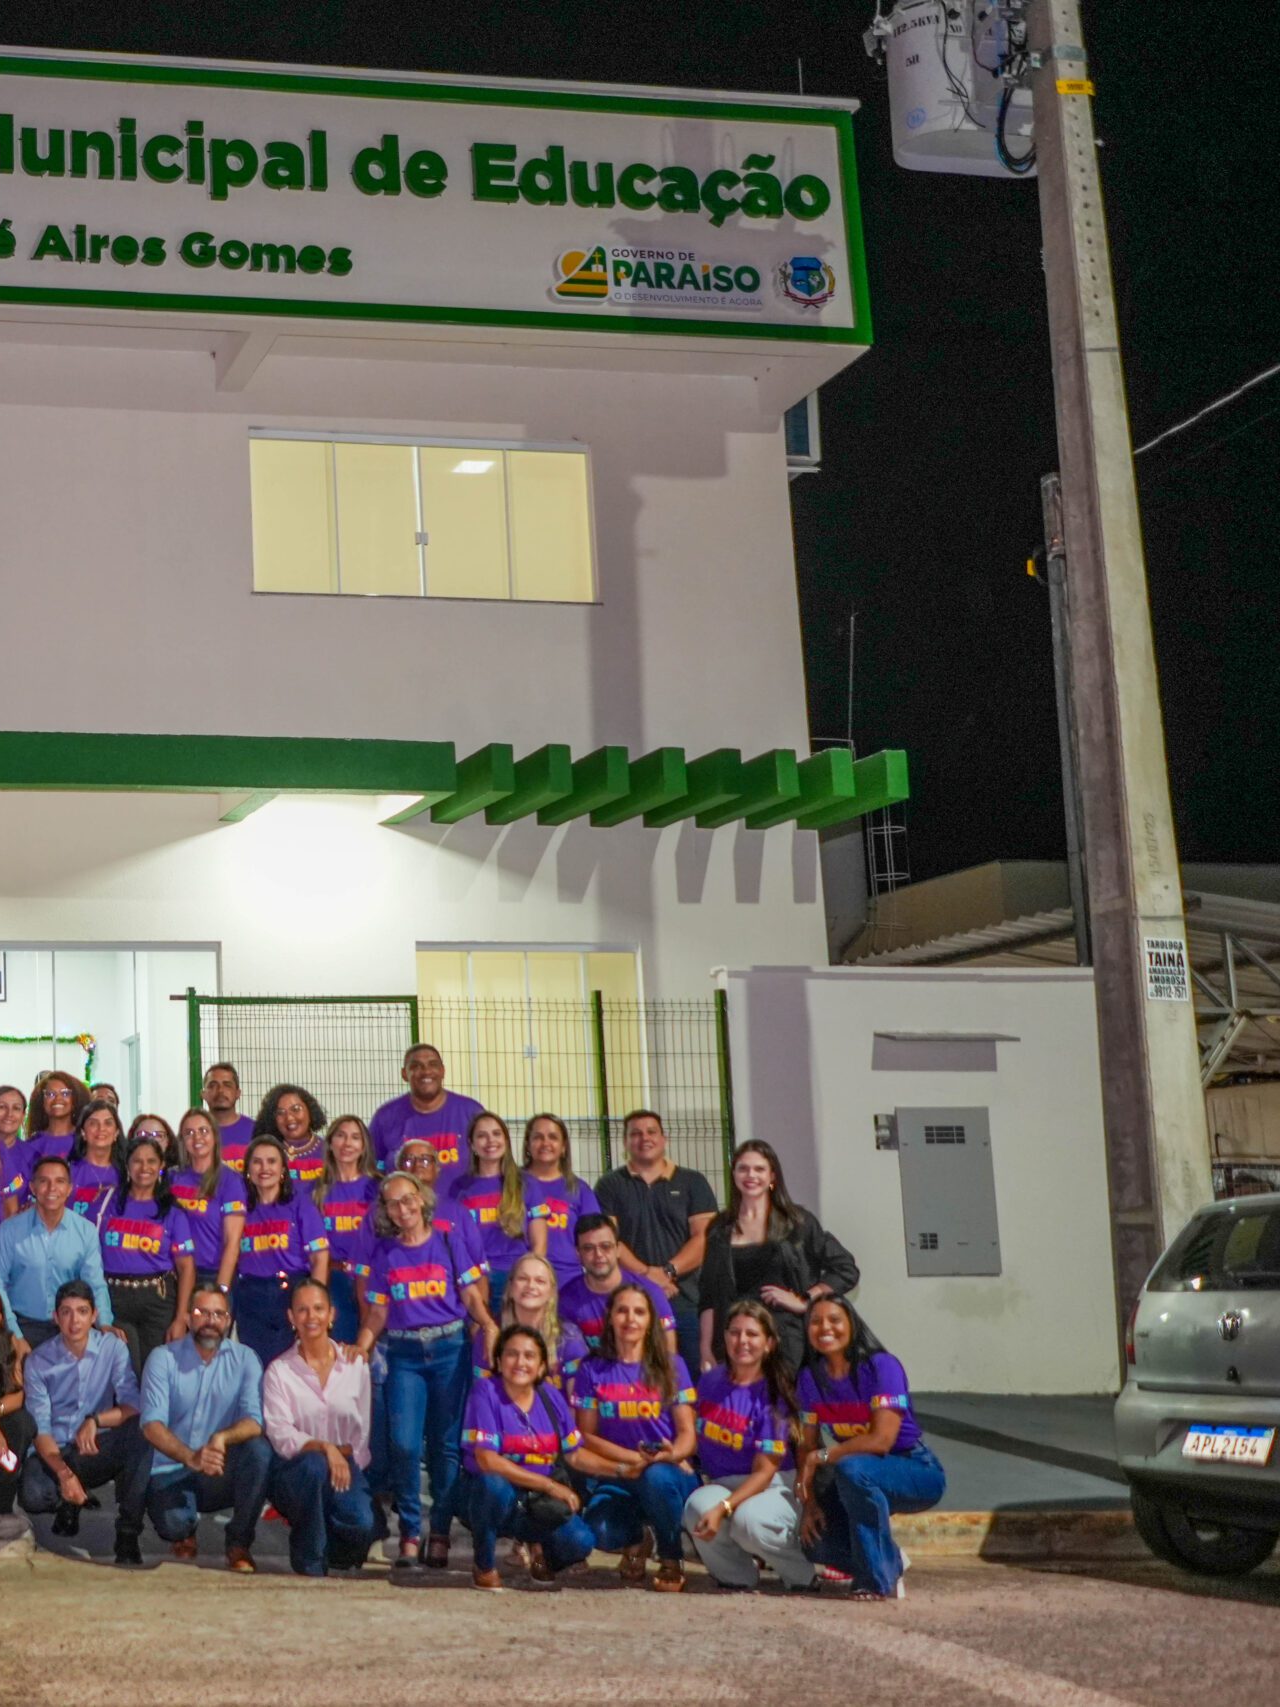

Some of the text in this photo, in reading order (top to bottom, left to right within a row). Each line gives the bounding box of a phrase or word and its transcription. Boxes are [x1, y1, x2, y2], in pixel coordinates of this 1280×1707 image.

[352, 135, 449, 198] de
[470, 142, 830, 227] Educação
[32, 225, 168, 266] Aires
[180, 231, 355, 277] Gomes
[611, 248, 696, 262] GOVERNO DE
[624, 293, 719, 305] DESENVOLVIMENTO
[729, 297, 762, 306] AGORA
[1149, 975, 1186, 985] AMOROSA
[105, 1231, 161, 1255] 62 ANOS
[252, 1233, 289, 1252] ANOS
[599, 1400, 661, 1419] 62 ANOS
[703, 1420, 743, 1451] ANOS
